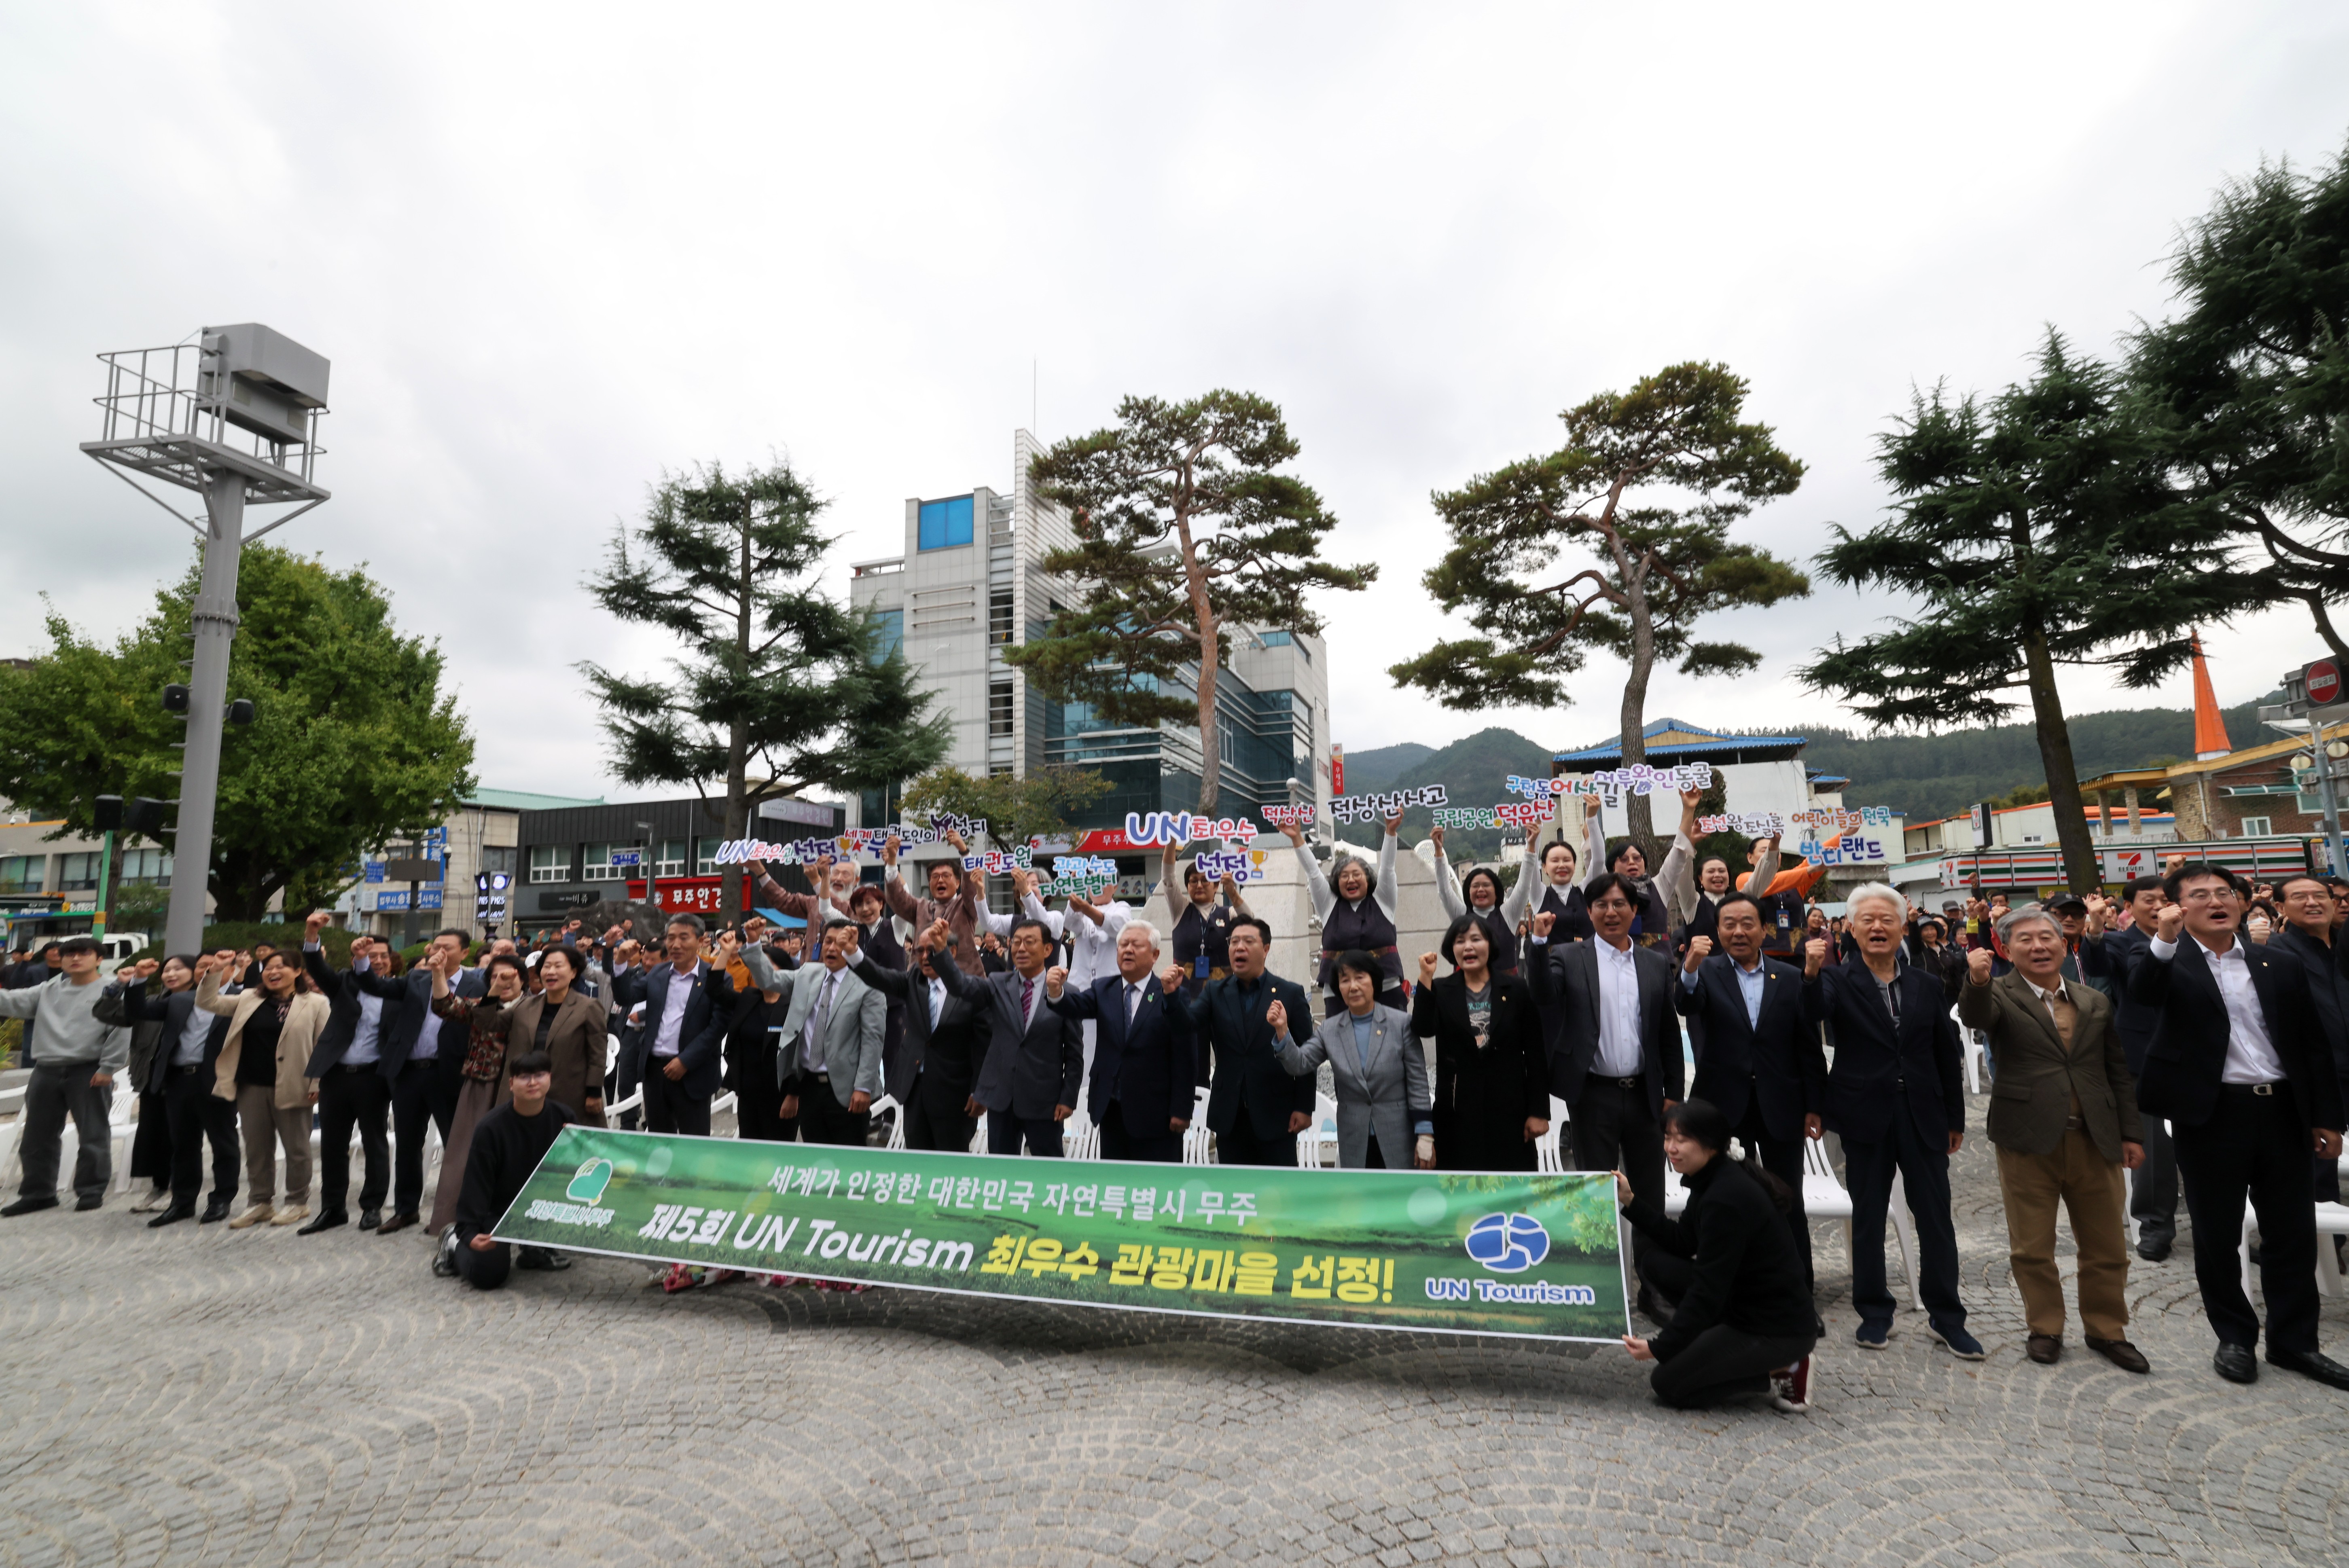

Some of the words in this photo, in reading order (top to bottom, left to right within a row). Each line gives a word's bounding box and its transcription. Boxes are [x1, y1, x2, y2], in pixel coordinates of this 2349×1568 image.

[2311, 676, 2334, 688] 진입금지
[953, 817, 986, 836] 성지
[1263, 806, 1314, 824] 적상산
[1434, 810, 1493, 829] 국립공원
[1497, 800, 1555, 826] 덕유산
[1129, 815, 1188, 841] UN
[1192, 819, 1256, 842] 최우수
[718, 841, 756, 861] UN
[964, 847, 1031, 873] 태권도원
[1800, 837, 1884, 865] 반디랜드
[1053, 855, 1116, 877] 관광수도
[1197, 852, 1248, 882] 선정
[2117, 853, 2141, 880] 7
[1038, 874, 1116, 899] 자연특별시
[767, 1165, 840, 1199] 세계가
[847, 1170, 922, 1205] 인정한
[928, 1176, 1035, 1213] 대한민국
[1042, 1183, 1186, 1223] 자연특별시
[1196, 1191, 1258, 1226] 무주
[638, 1204, 737, 1246] 제5회
[733, 1213, 800, 1253] UN
[803, 1219, 974, 1272] Tourism
[981, 1234, 1099, 1281] 최우수
[1108, 1244, 1279, 1295] 관광마을
[1290, 1255, 1394, 1304] 선정!
[1427, 1280, 1468, 1298] UN
[1476, 1282, 1593, 1302] Tourism
